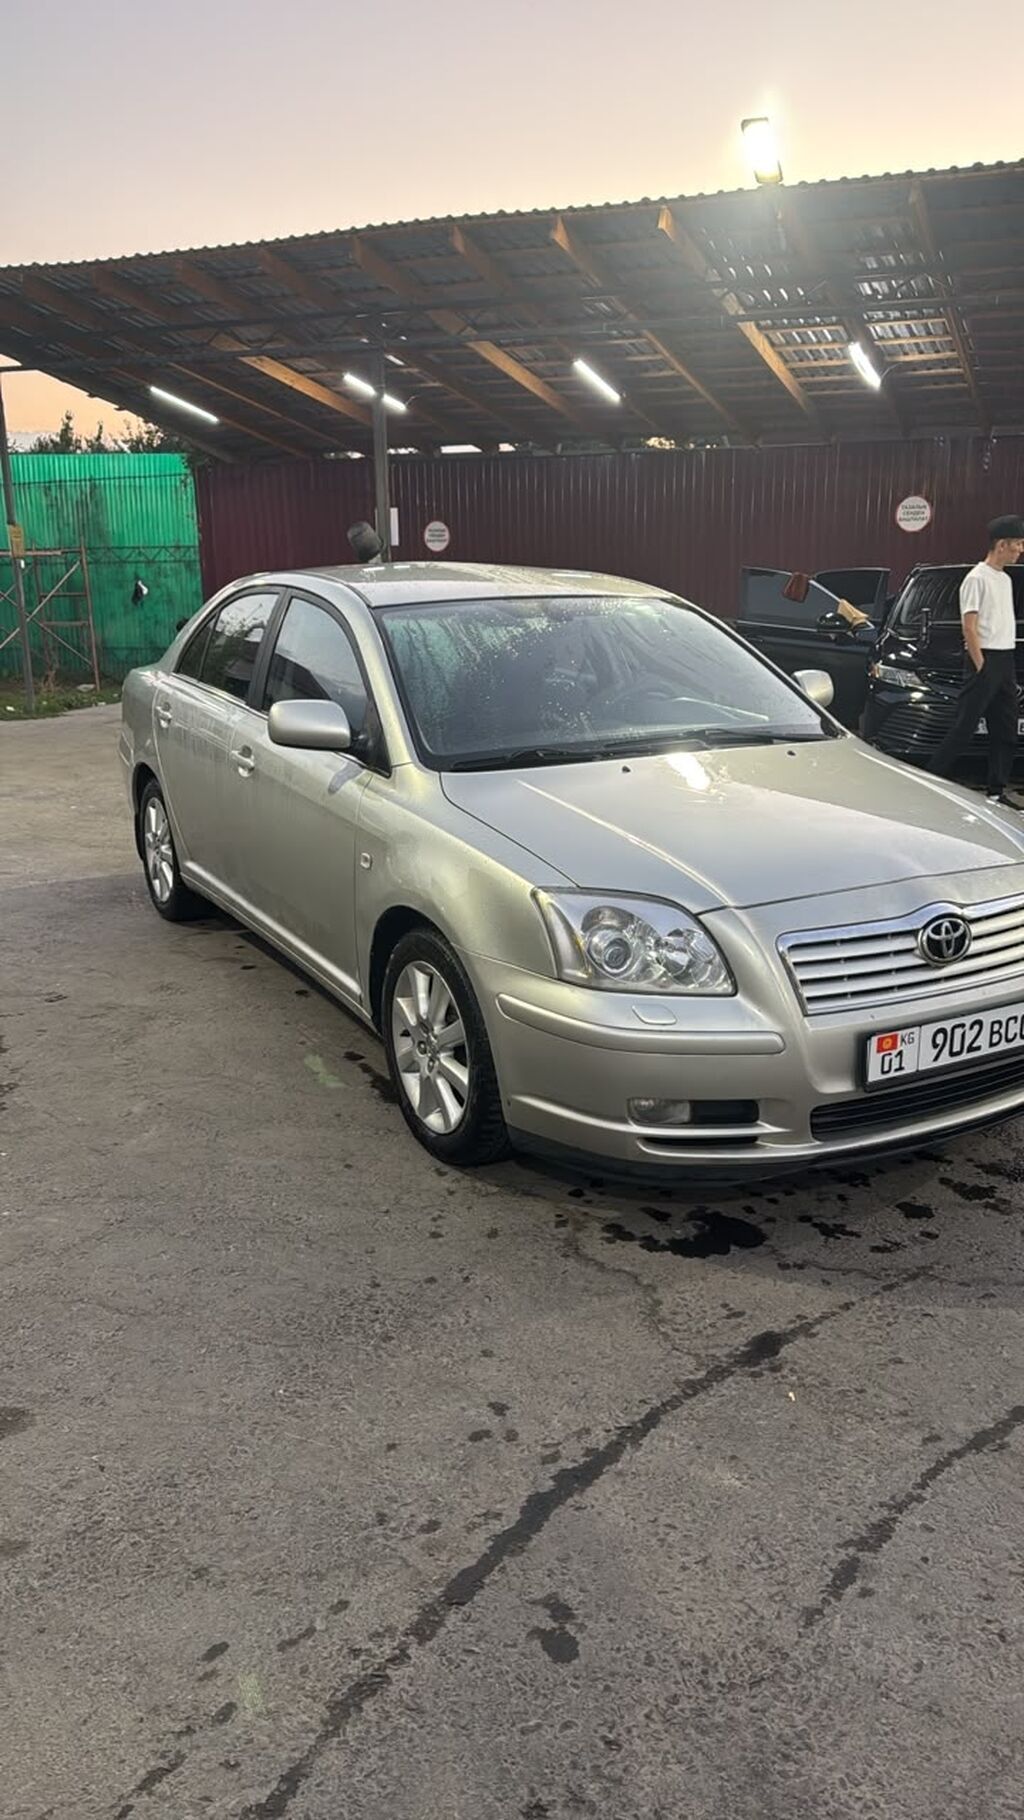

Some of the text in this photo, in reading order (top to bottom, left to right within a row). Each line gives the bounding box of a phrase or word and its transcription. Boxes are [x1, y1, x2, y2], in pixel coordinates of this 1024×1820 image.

[900, 1031, 915, 1047] KG
[931, 1018, 984, 1063] 902
[880, 1049, 905, 1075] 01
